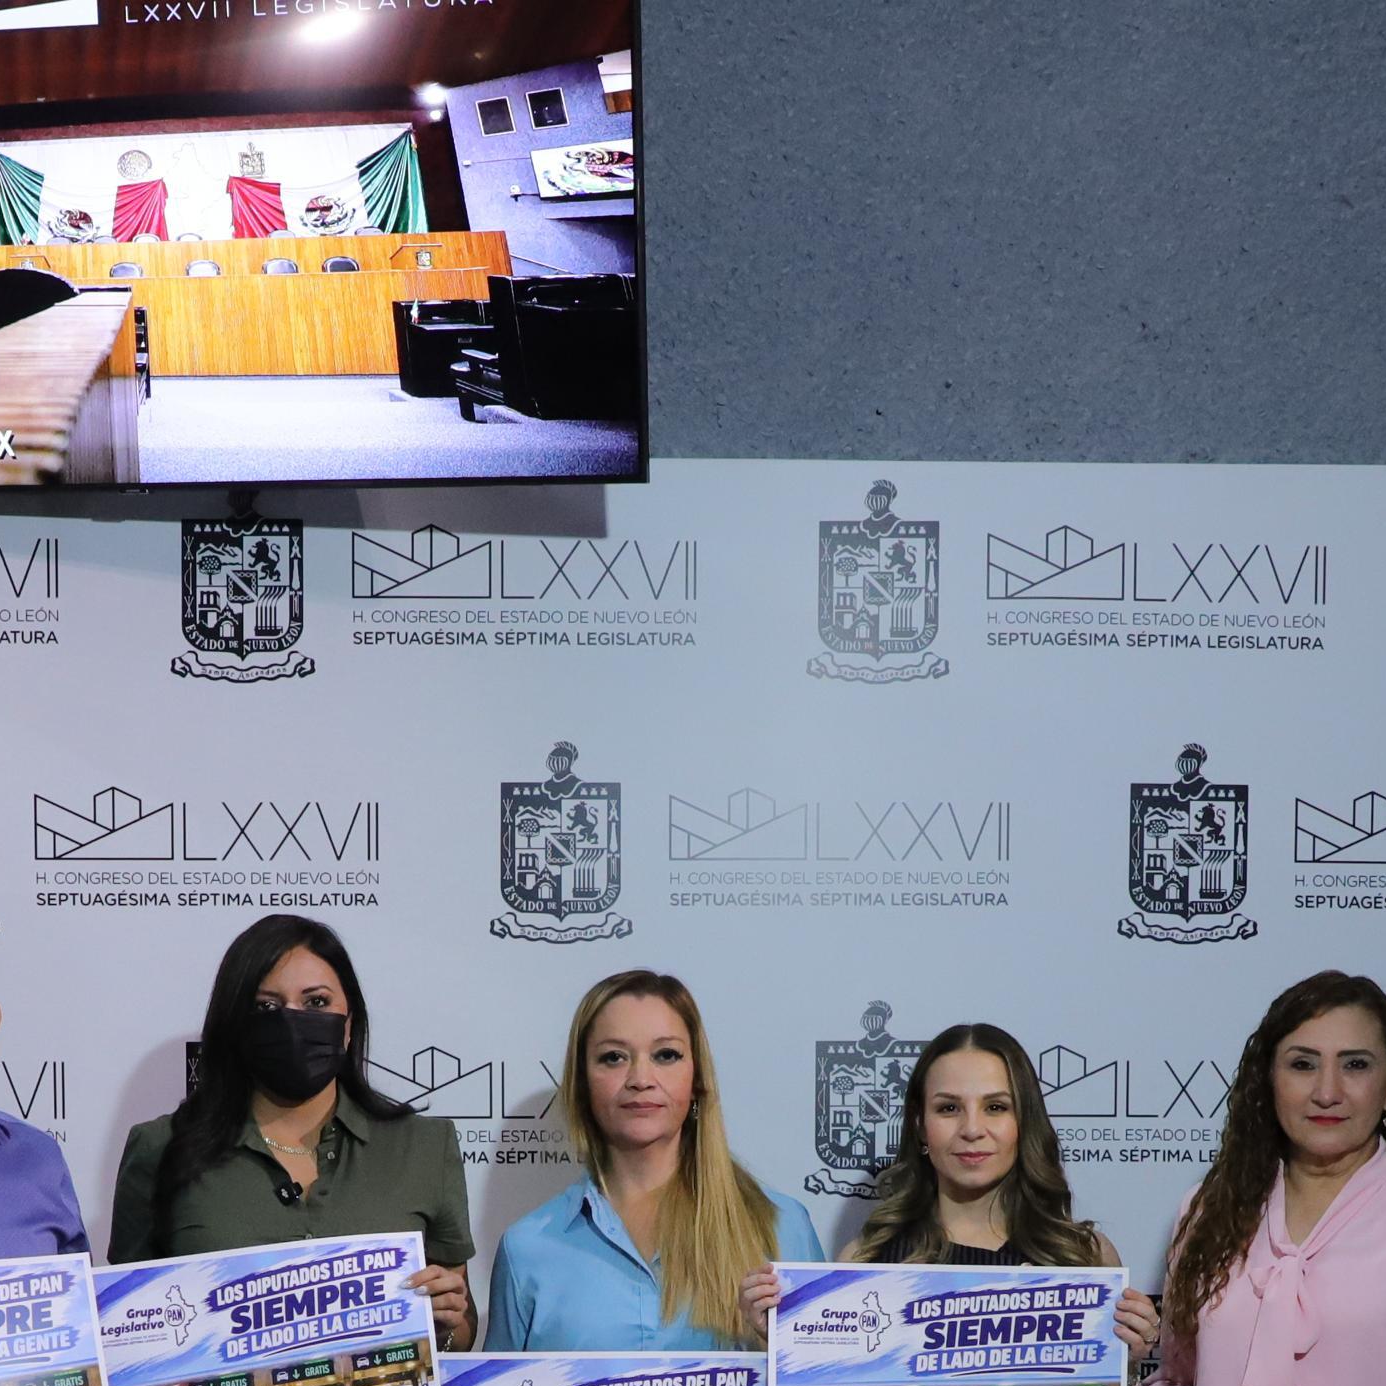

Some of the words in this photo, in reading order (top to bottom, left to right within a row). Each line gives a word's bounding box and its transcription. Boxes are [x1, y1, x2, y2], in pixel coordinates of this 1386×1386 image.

[1134, 543, 1326, 605] LXXVII
[16, 607, 59, 622] LEÓN
[988, 612, 1000, 624] H.
[1005, 611, 1093, 625] CONGRESO
[1099, 612, 1128, 625] DEL
[1133, 613, 1194, 626] ESTADO
[1199, 614, 1219, 627] DE
[1224, 614, 1279, 628] NUEVO
[1284, 613, 1325, 628] LEÓN
[987, 629, 1120, 646] SEPTUAGÉSIMA
[1127, 631, 1201, 648] SÉPTIMA
[1208, 635, 1324, 649] LEGISLATURA
[467, 1130, 496, 1143] DEL
[501, 1130, 563, 1143] ESTADO
[1092, 1129, 1120, 1141] DEL
[1126, 1129, 1186, 1142] ESTADO
[1191, 1129, 1211, 1142] DE
[496, 1148, 571, 1164] SÉPTIMA
[1119, 1147, 1193, 1163] SÉPTIMA
[216, 1285, 244, 1305] LOS
[246, 1265, 331, 1300] DIPUTADOS
[333, 1258, 361, 1278] DEL
[364, 1250, 397, 1271] PAN
[230, 1274, 386, 1335] SIEMPRE
[913, 1300, 941, 1319] LOS
[942, 1294, 1031, 1317] DIPUTADOS
[1033, 1291, 1062, 1309] DEL
[1065, 1286, 1100, 1306] PAN
[126, 1306, 163, 1321] Grupo
[167, 1309, 183, 1321] PAN
[821, 1308, 858, 1322] Grupo
[862, 1314, 878, 1328] PAN
[100, 1319, 165, 1339] Legislativo
[227, 1338, 248, 1358] DE
[251, 1328, 295, 1352] LADO
[297, 1324, 320, 1345] DE
[322, 1317, 343, 1336] LA
[346, 1302, 403, 1330] GENTE
[793, 1320, 859, 1336] Legislativo
[923, 1311, 1085, 1350] SIEMPRE
[386, 1348, 415, 1363] GRATIS
[916, 1353, 939, 1372] DE
[941, 1350, 987, 1369] LADO
[989, 1349, 1012, 1366] DE
[1015, 1347, 1037, 1364] LA
[1040, 1343, 1098, 1363] GENTE
[305, 1363, 330, 1377] GRATIS
